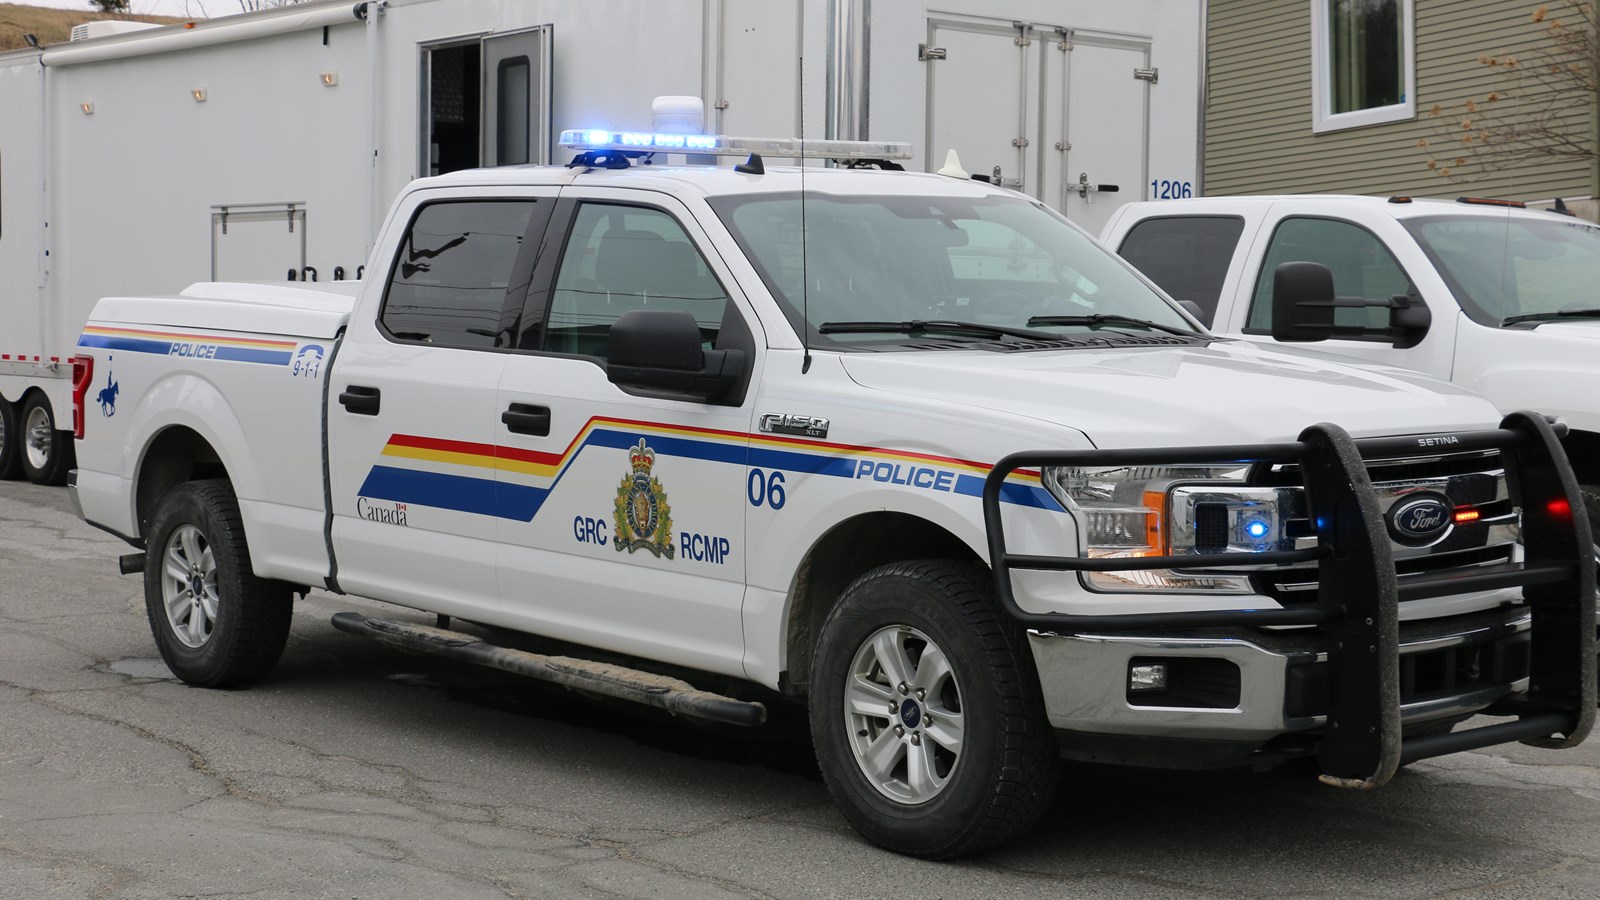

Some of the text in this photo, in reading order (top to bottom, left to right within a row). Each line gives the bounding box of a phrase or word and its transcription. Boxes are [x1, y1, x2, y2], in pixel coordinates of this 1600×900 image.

[1151, 179, 1192, 199] 1206
[169, 343, 215, 359] POLICE
[293, 360, 320, 378] 9-1-1
[1417, 436, 1459, 447] SETINA
[856, 460, 955, 492] POLICE
[748, 468, 786, 510] 06
[357, 496, 408, 527] Canada
[1410, 507, 1441, 529] Ford
[574, 515, 607, 545] GRC
[680, 532, 730, 564] RCMP
